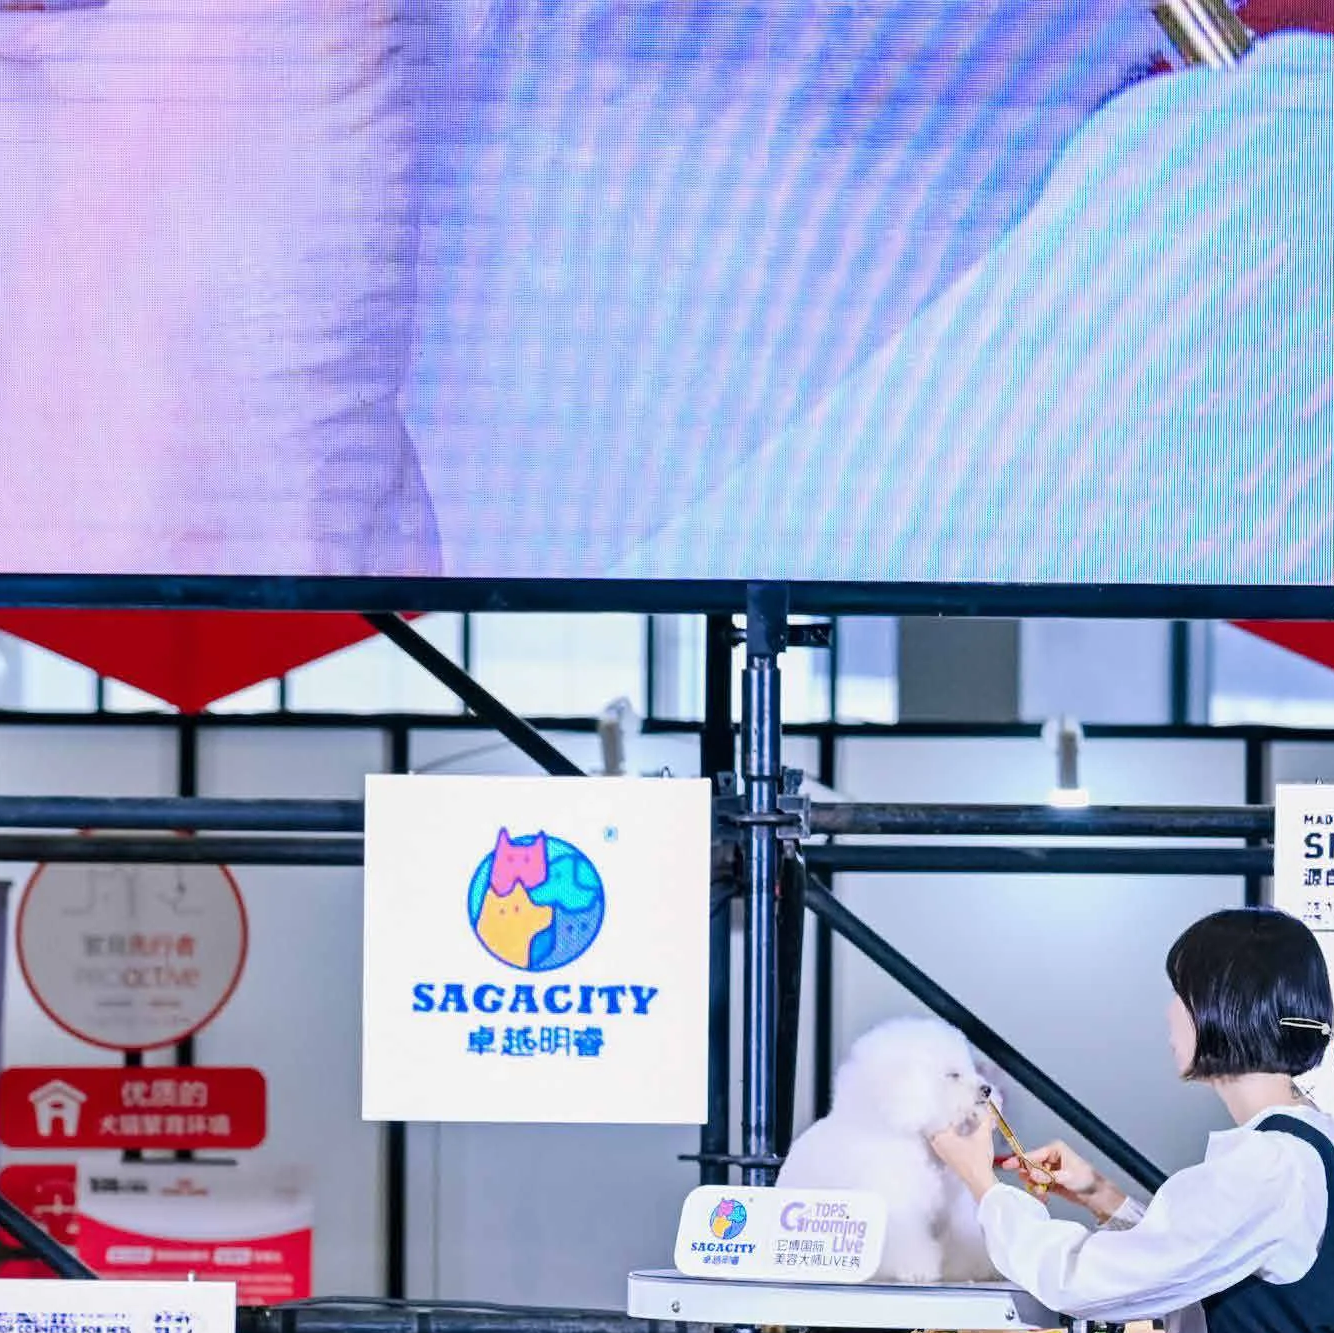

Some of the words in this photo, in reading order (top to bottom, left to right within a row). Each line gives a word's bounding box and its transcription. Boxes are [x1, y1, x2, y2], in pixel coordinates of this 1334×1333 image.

[412, 982, 659, 1016] SAGACITY
[466, 1025, 605, 1057] 卓越明睿
[691, 1241, 757, 1255] SAGACITY
